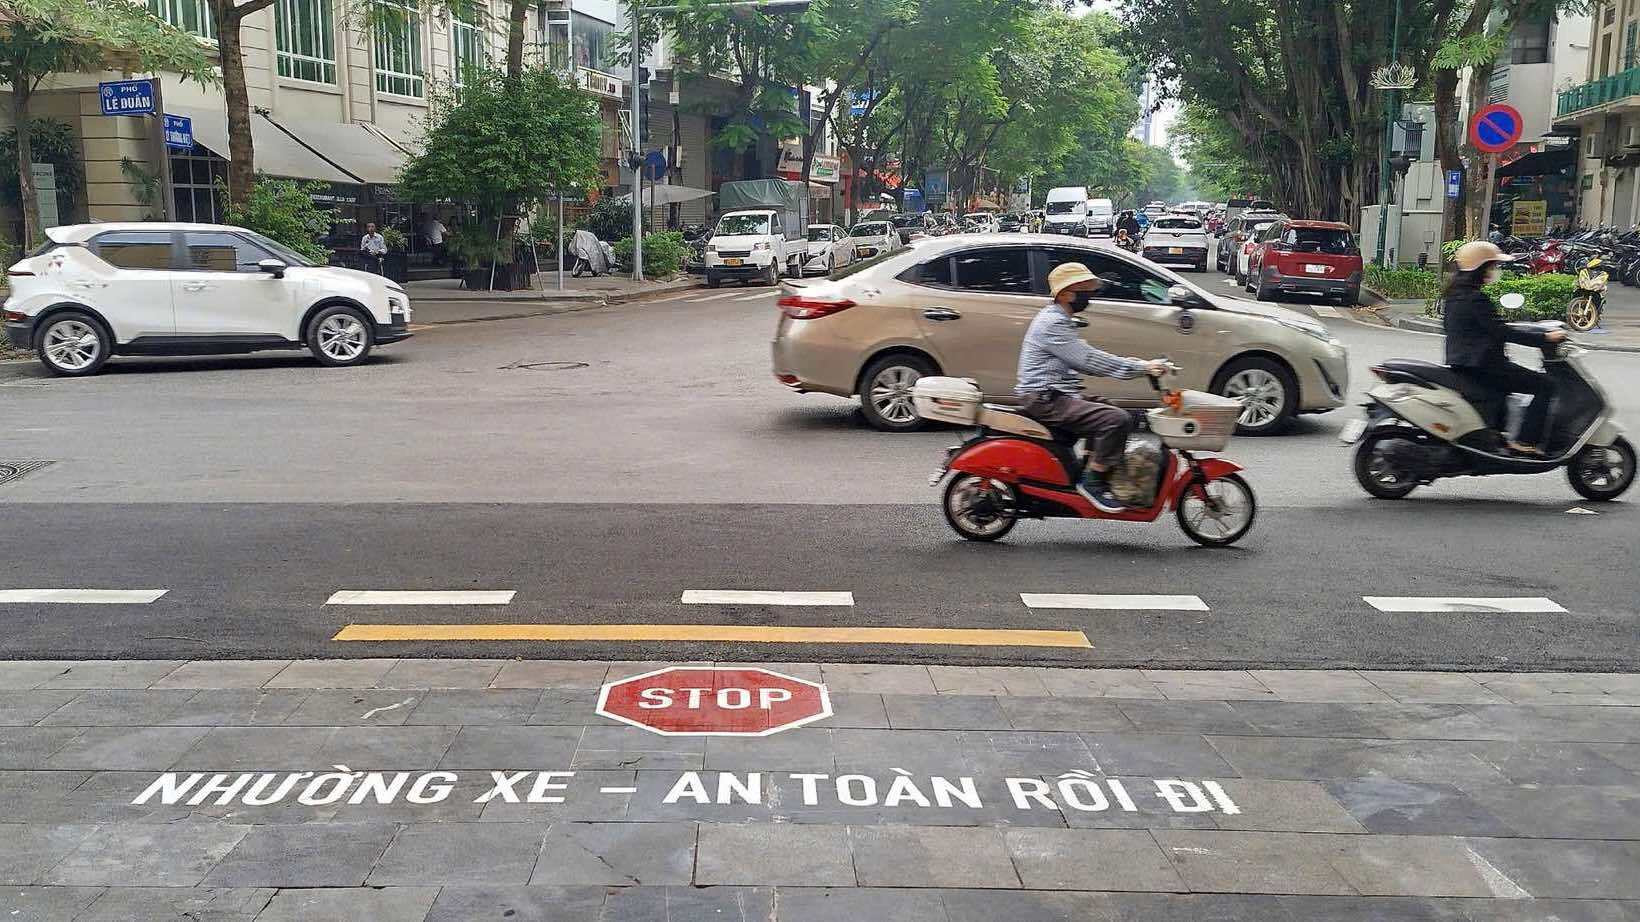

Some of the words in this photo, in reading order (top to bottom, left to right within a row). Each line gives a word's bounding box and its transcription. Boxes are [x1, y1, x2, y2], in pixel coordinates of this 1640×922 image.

[121, 84, 138, 93] PHỐ
[105, 96, 119, 110] LÊ
[638, 687, 792, 710] STOP
[130, 764, 459, 806] NHƯỜNG
[474, 771, 575, 803] XE
[662, 771, 762, 804] AN
[789, 768, 983, 809] TOÀN
[1005, 769, 1138, 812] RỒI
[1153, 779, 1242, 815] ĐI
